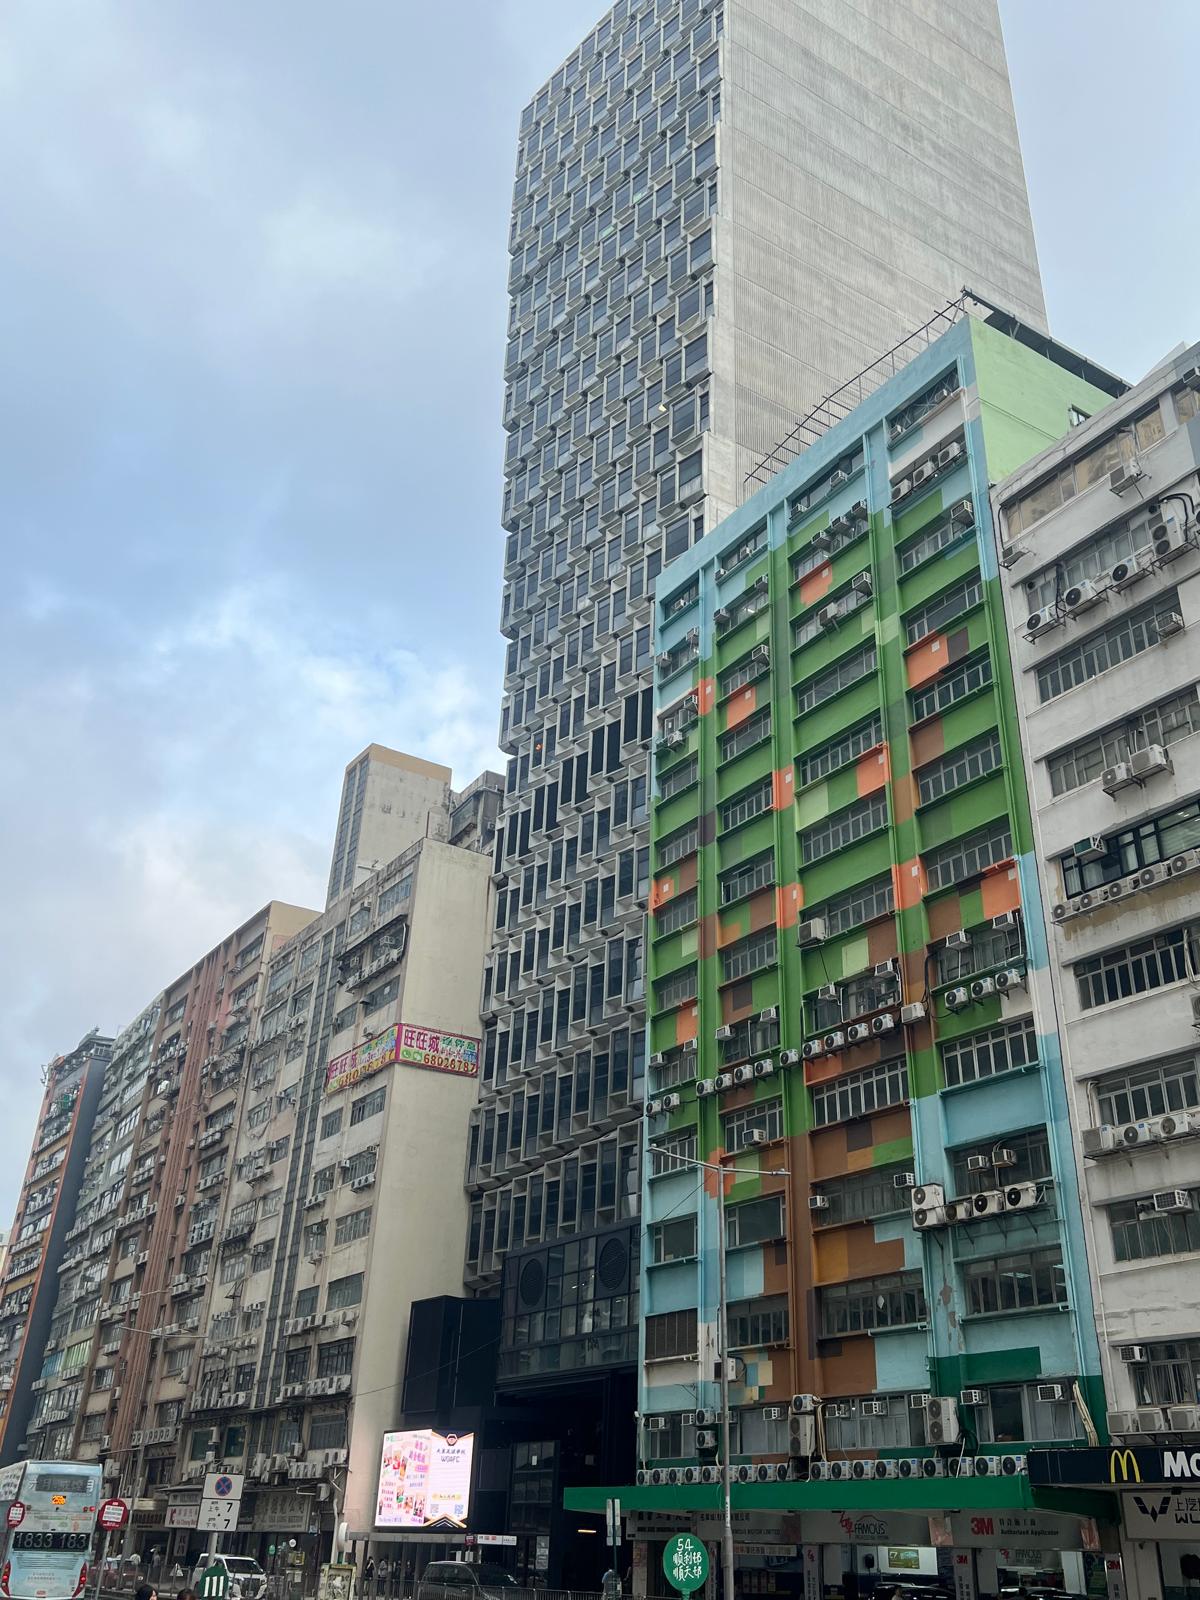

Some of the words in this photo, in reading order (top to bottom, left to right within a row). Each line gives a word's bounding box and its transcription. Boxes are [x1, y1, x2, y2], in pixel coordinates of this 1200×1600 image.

[404, 1029, 440, 1053] 旺旺城
[424, 1053, 476, 1072] 68028787
[226, 1502, 233, 1513] 7
[1175, 1497, 1200, 1512] 上汽
[224, 1519, 230, 1529] 7
[970, 1517, 994, 1535] 3M
[676, 1538, 695, 1551] 54
[673, 1551, 702, 1566] 順利邨
[956, 1555, 968, 1564] 3M
[1107, 1560, 1120, 1570] 3M
[203, 1576, 225, 1597] 111
